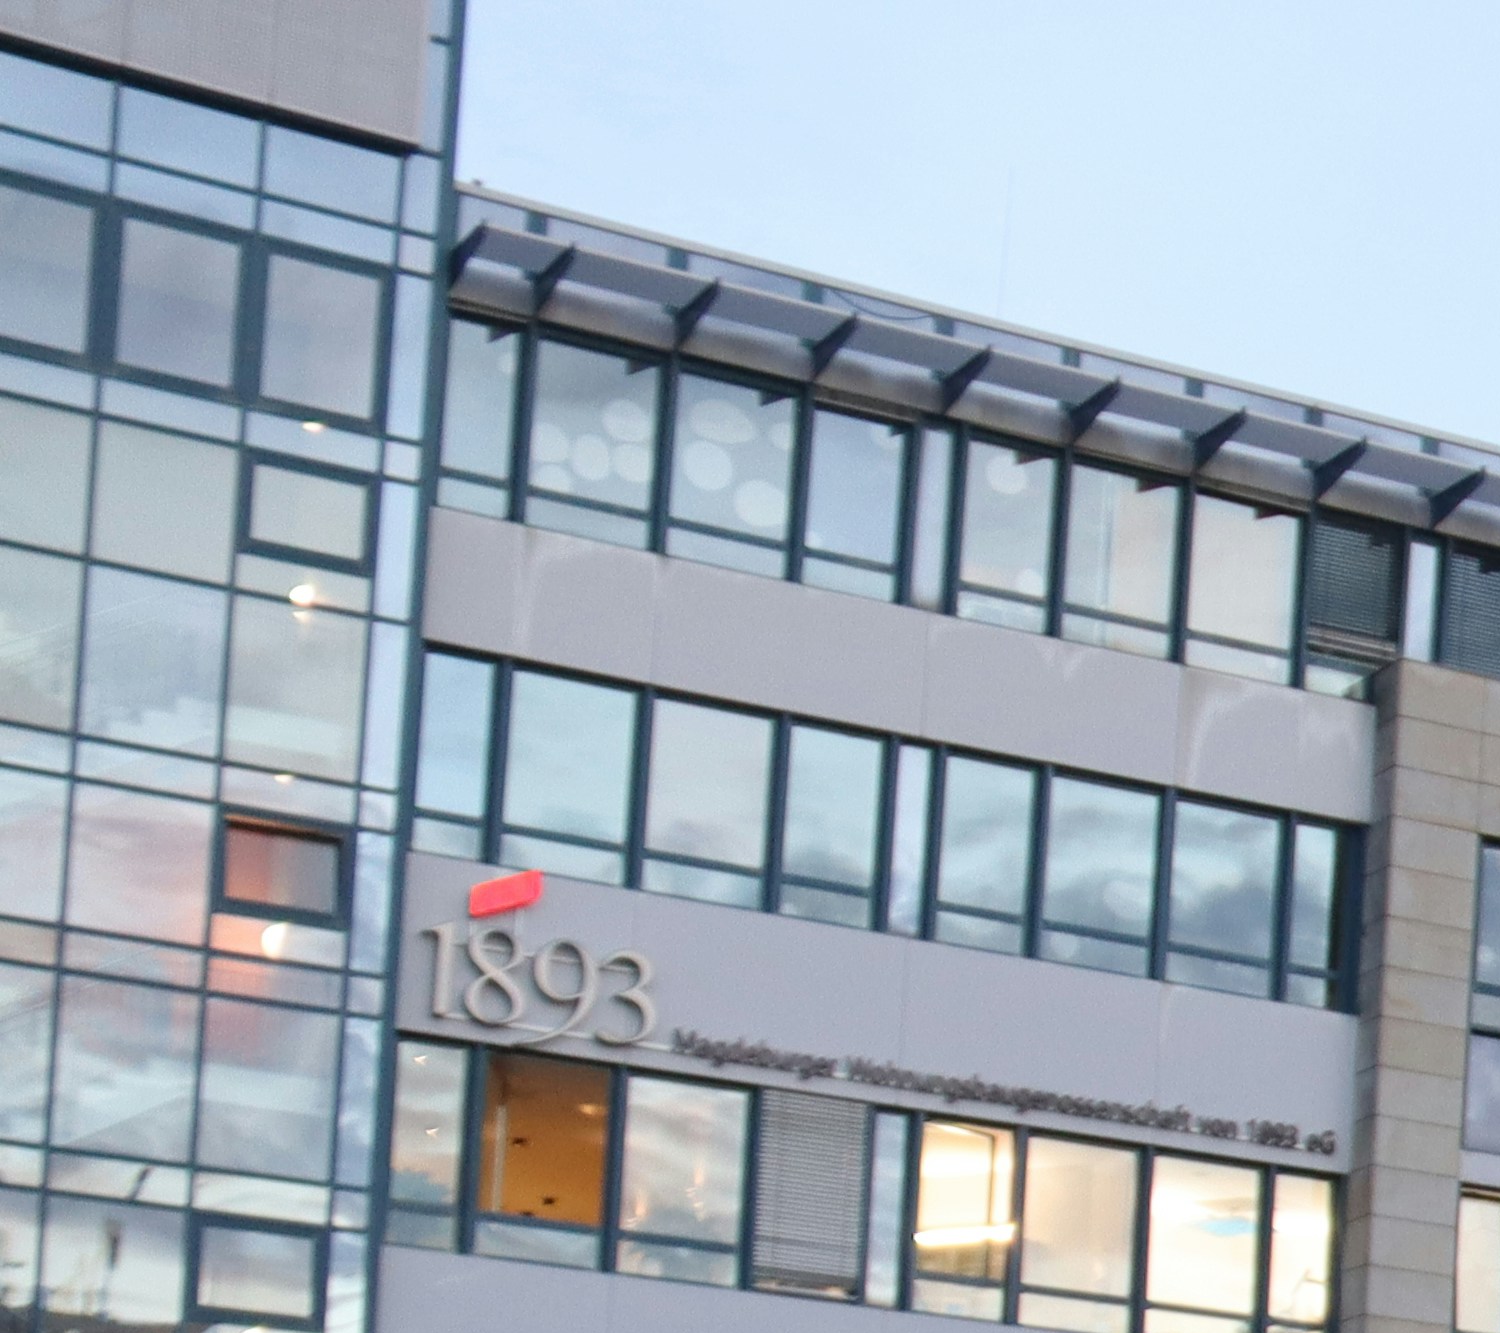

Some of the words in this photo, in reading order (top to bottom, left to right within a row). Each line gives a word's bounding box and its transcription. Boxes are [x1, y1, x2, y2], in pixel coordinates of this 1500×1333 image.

[418, 921, 658, 1046] 1893
[671, 1027, 837, 1079] Magdeburger
[1199, 1116, 1238, 1140] von
[1247, 1118, 1298, 1149] 1893
[1305, 1129, 1336, 1155] eG
